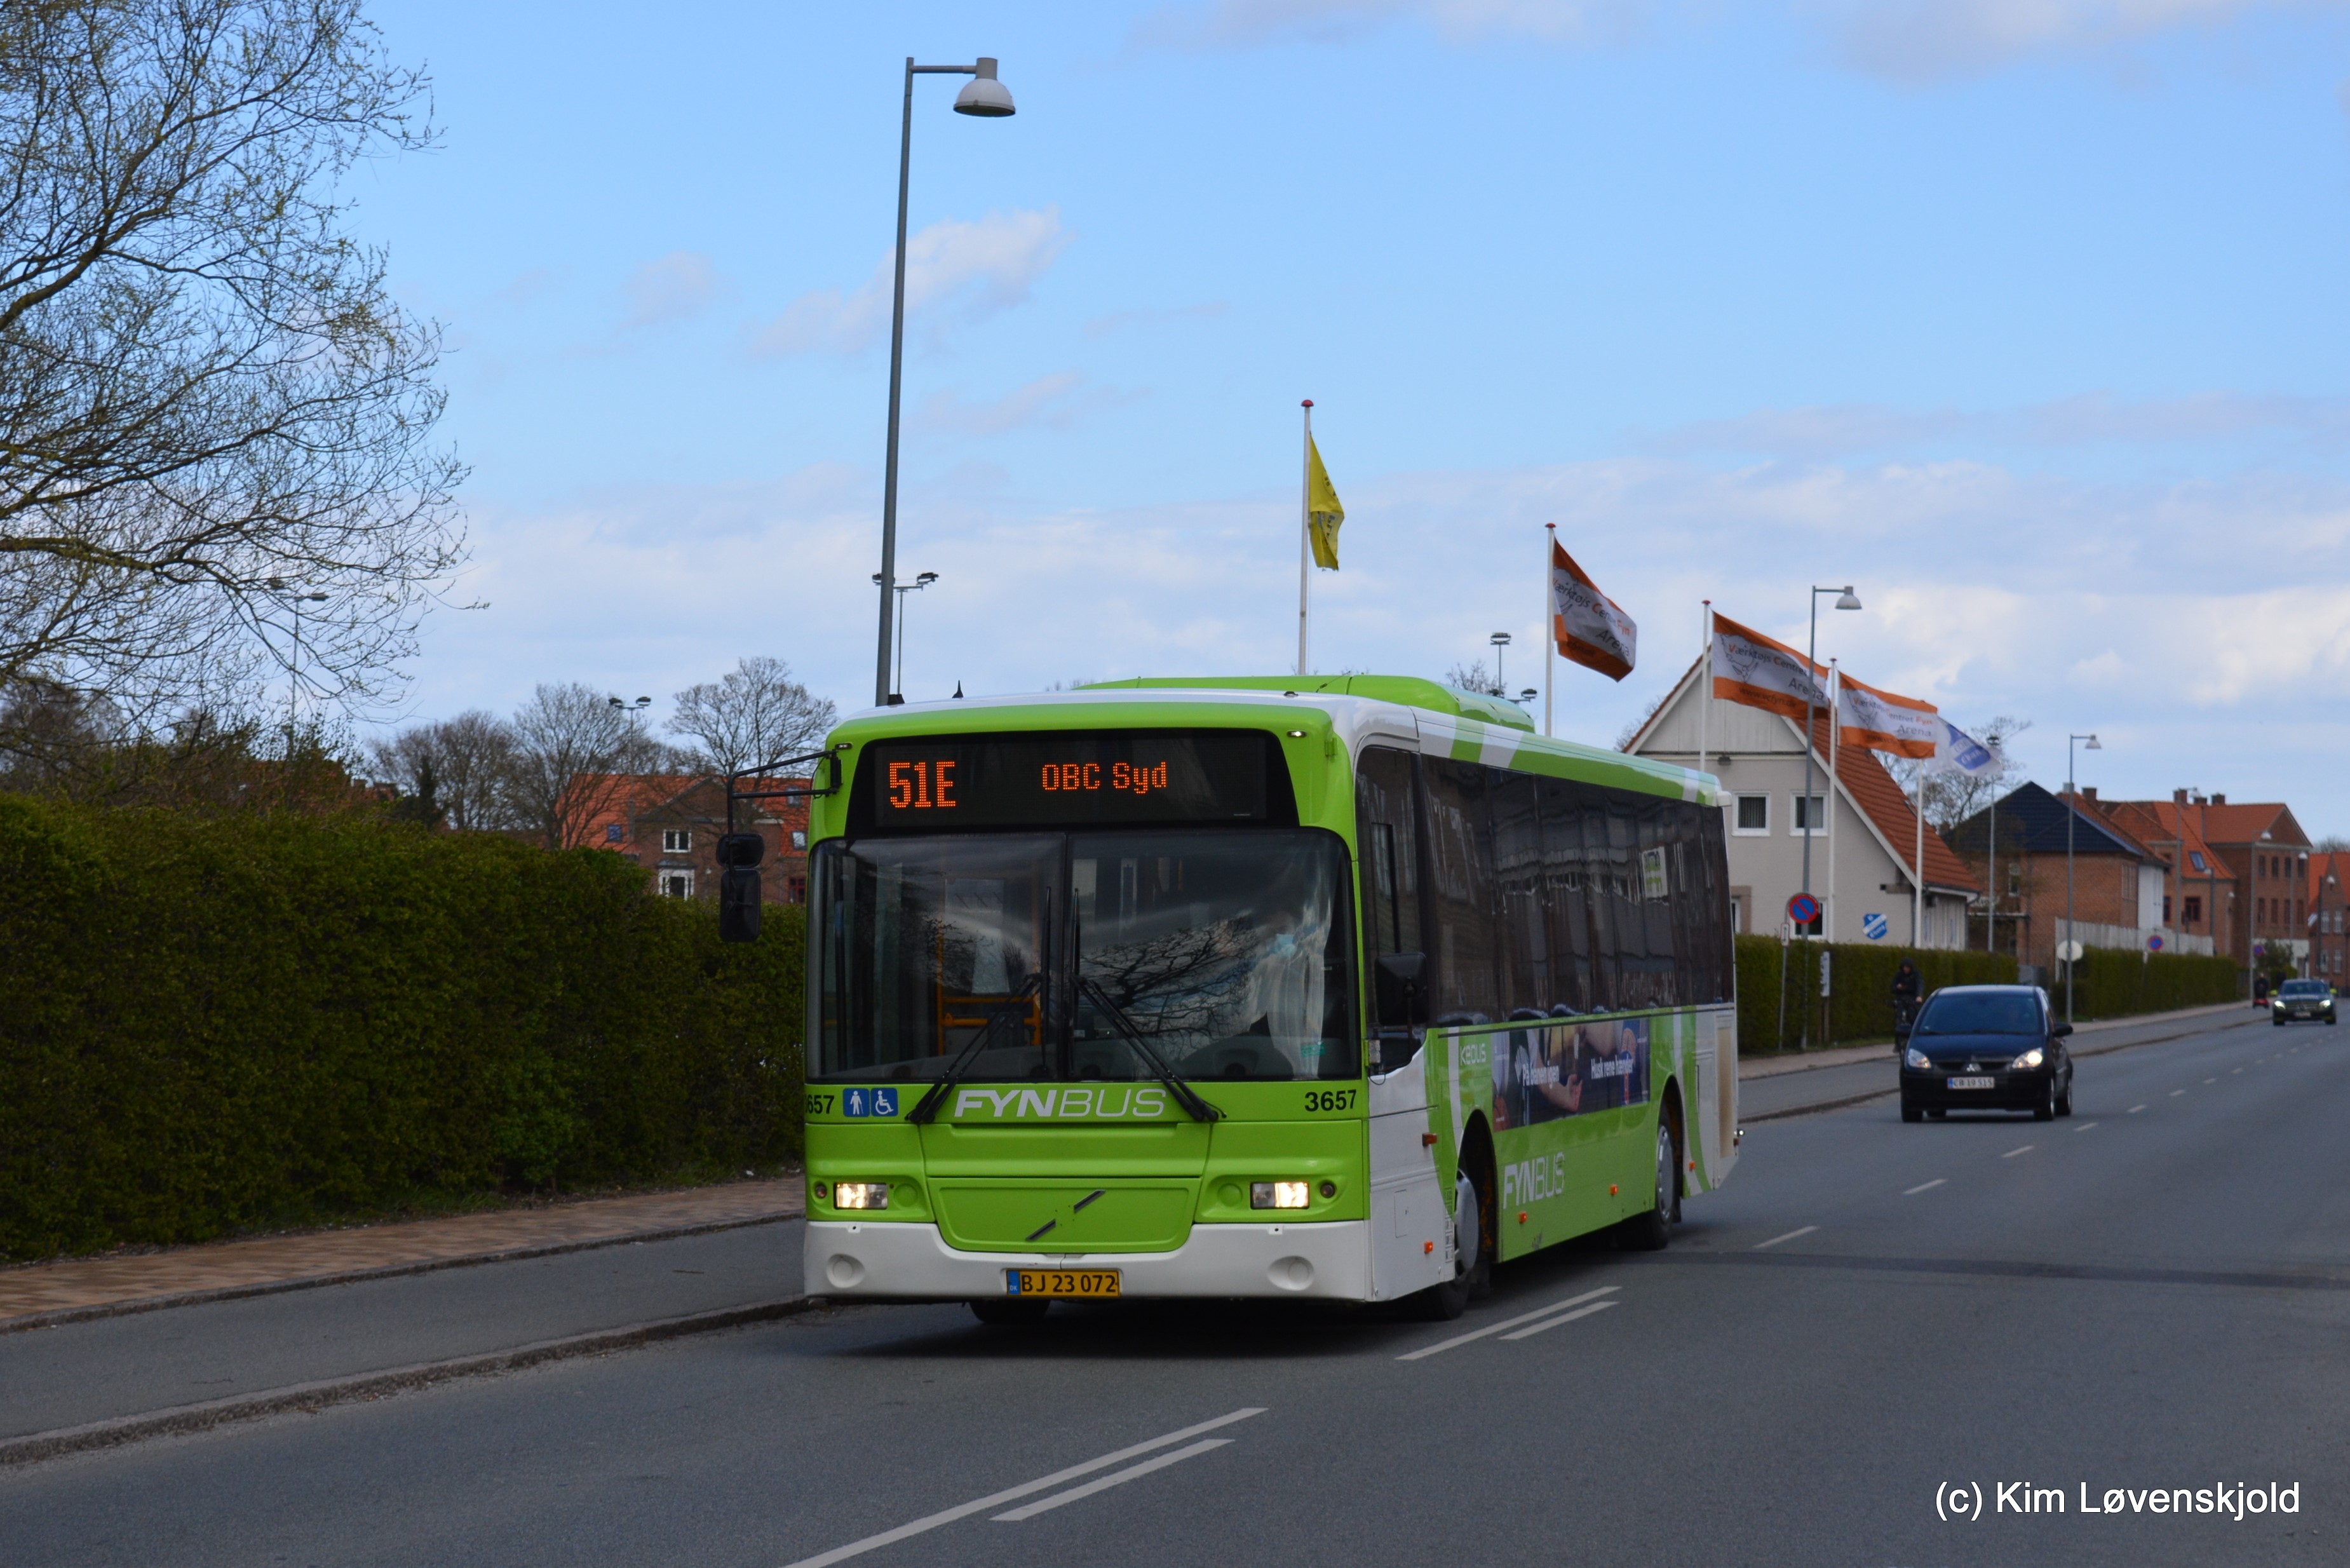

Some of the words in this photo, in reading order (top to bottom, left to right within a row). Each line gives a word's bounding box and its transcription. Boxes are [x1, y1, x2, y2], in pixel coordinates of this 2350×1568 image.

[1595, 630, 1630, 656] Arena
[1728, 643, 1771, 663] Værktøjs
[1897, 725, 1931, 737] Arena
[889, 761, 956, 809] 51E
[1041, 762, 1101, 791] OBC
[1112, 760, 1168, 795] Syd
[954, 1088, 1166, 1118] FYNBUS
[1304, 1089, 1357, 1112] 3657
[1503, 1151, 1565, 1210] FYNBUS
[1021, 1274, 1046, 1292] BJ
[1052, 1274, 1076, 1292] 23
[1080, 1274, 1116, 1292] 072
